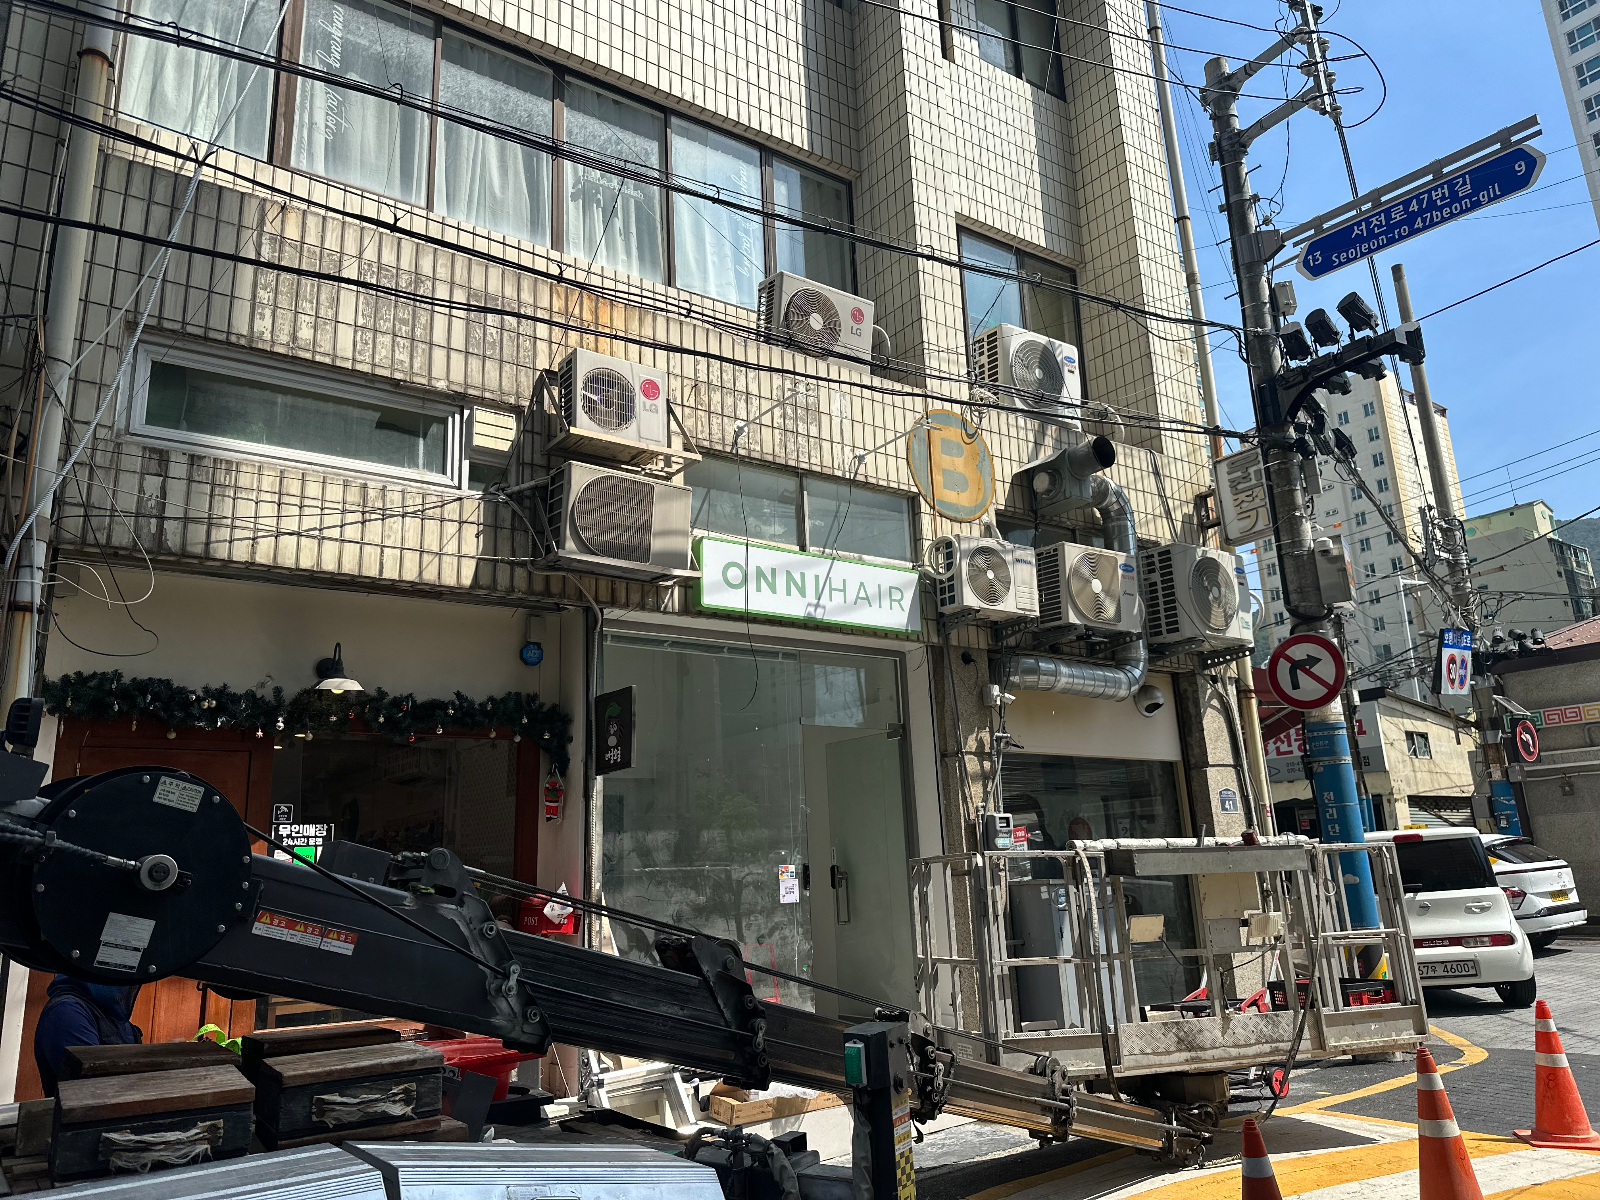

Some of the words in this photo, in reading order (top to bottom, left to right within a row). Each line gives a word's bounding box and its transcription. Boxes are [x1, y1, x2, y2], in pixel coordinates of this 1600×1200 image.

[313, 86, 350, 142] factory
[1514, 160, 1527, 176] 9
[1351, 174, 1472, 239] 서전로47번길
[1331, 224, 1409, 267] Seojeon-ro
[1414, 183, 1502, 229] 47beon-gil
[1307, 250, 1323, 267] 13
[850, 325, 862, 337] LG
[642, 400, 659, 415] LG
[925, 422, 985, 507] B
[1225, 451, 1271, 534] 우진전기
[1225, 800, 1234, 810] 41
[1322, 791, 1342, 845] 전리단
[278, 823, 329, 838] 무인매장
[282, 837, 308, 847] 24시간
[308, 837, 323, 846] 운영
[523, 916, 539, 926] POST
[1442, 962, 1470, 975] 4600
